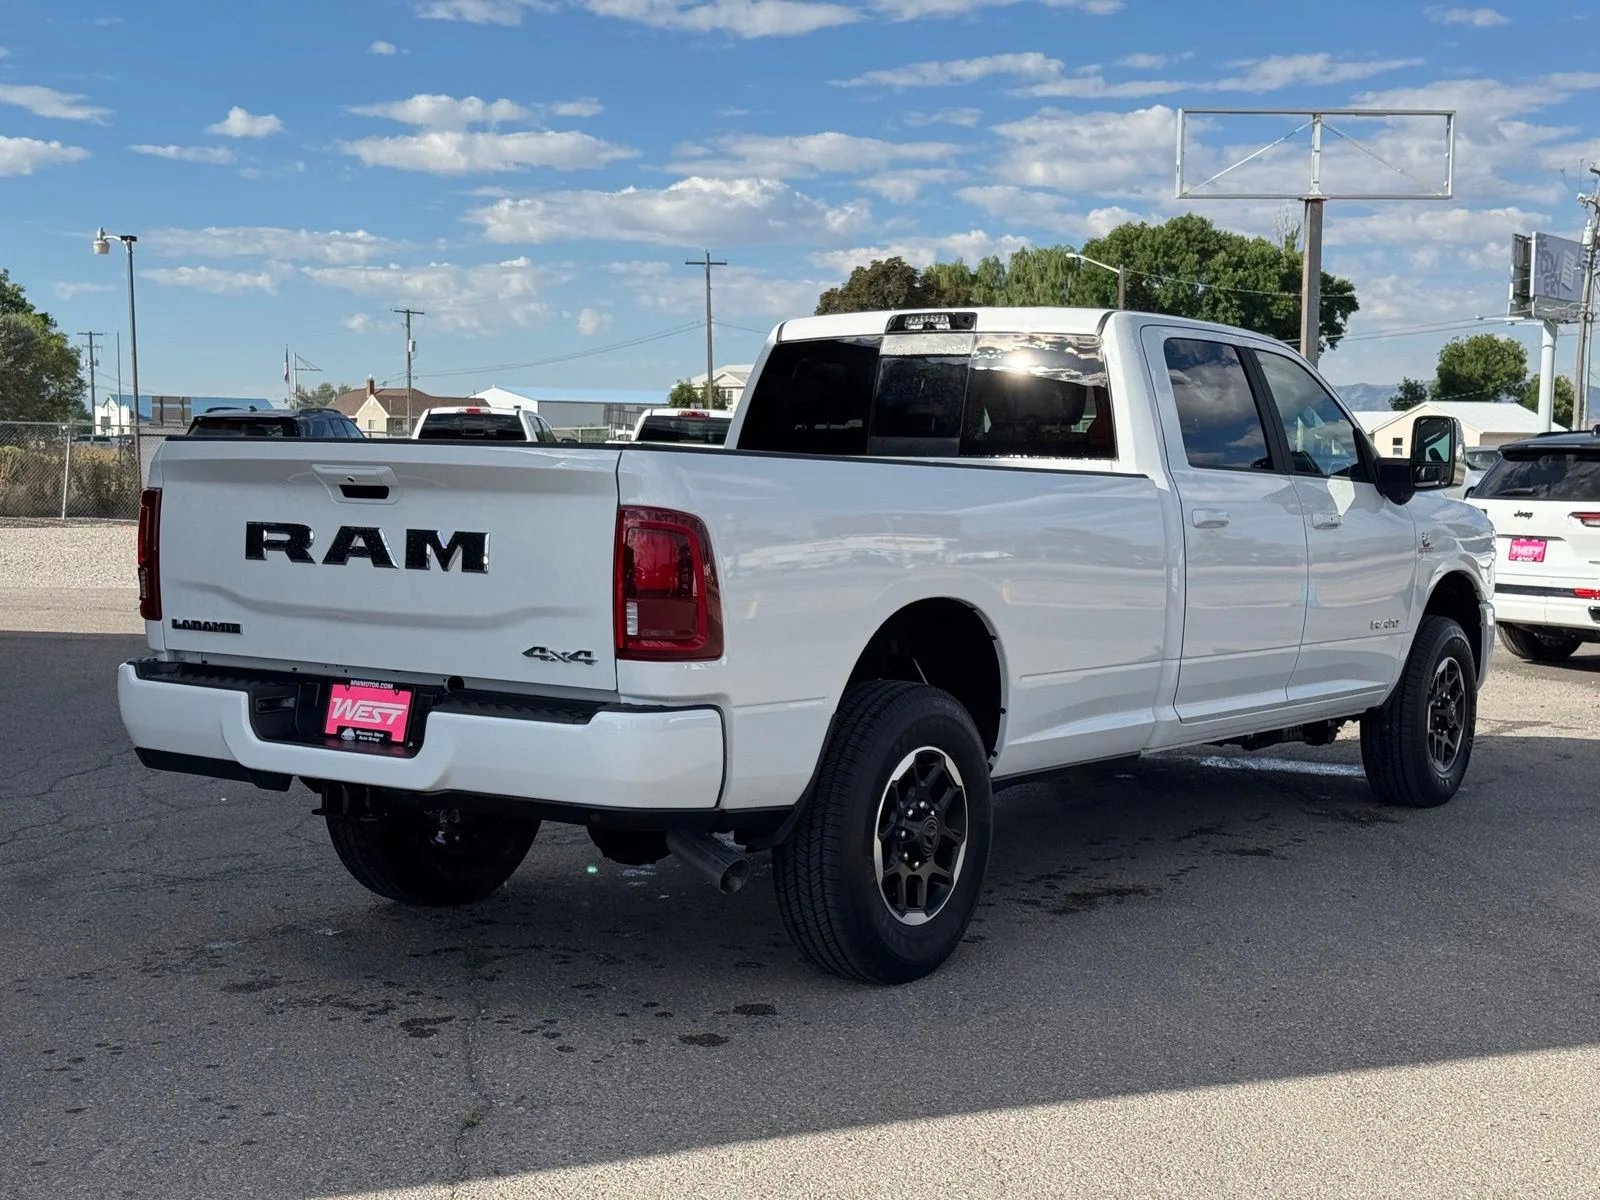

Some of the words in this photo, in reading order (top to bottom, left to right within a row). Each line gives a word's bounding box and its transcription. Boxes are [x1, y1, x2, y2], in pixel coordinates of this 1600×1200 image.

[1513, 510, 1534, 519] Jeep
[245, 521, 491, 574] RAM
[331, 697, 407, 725] WEST
